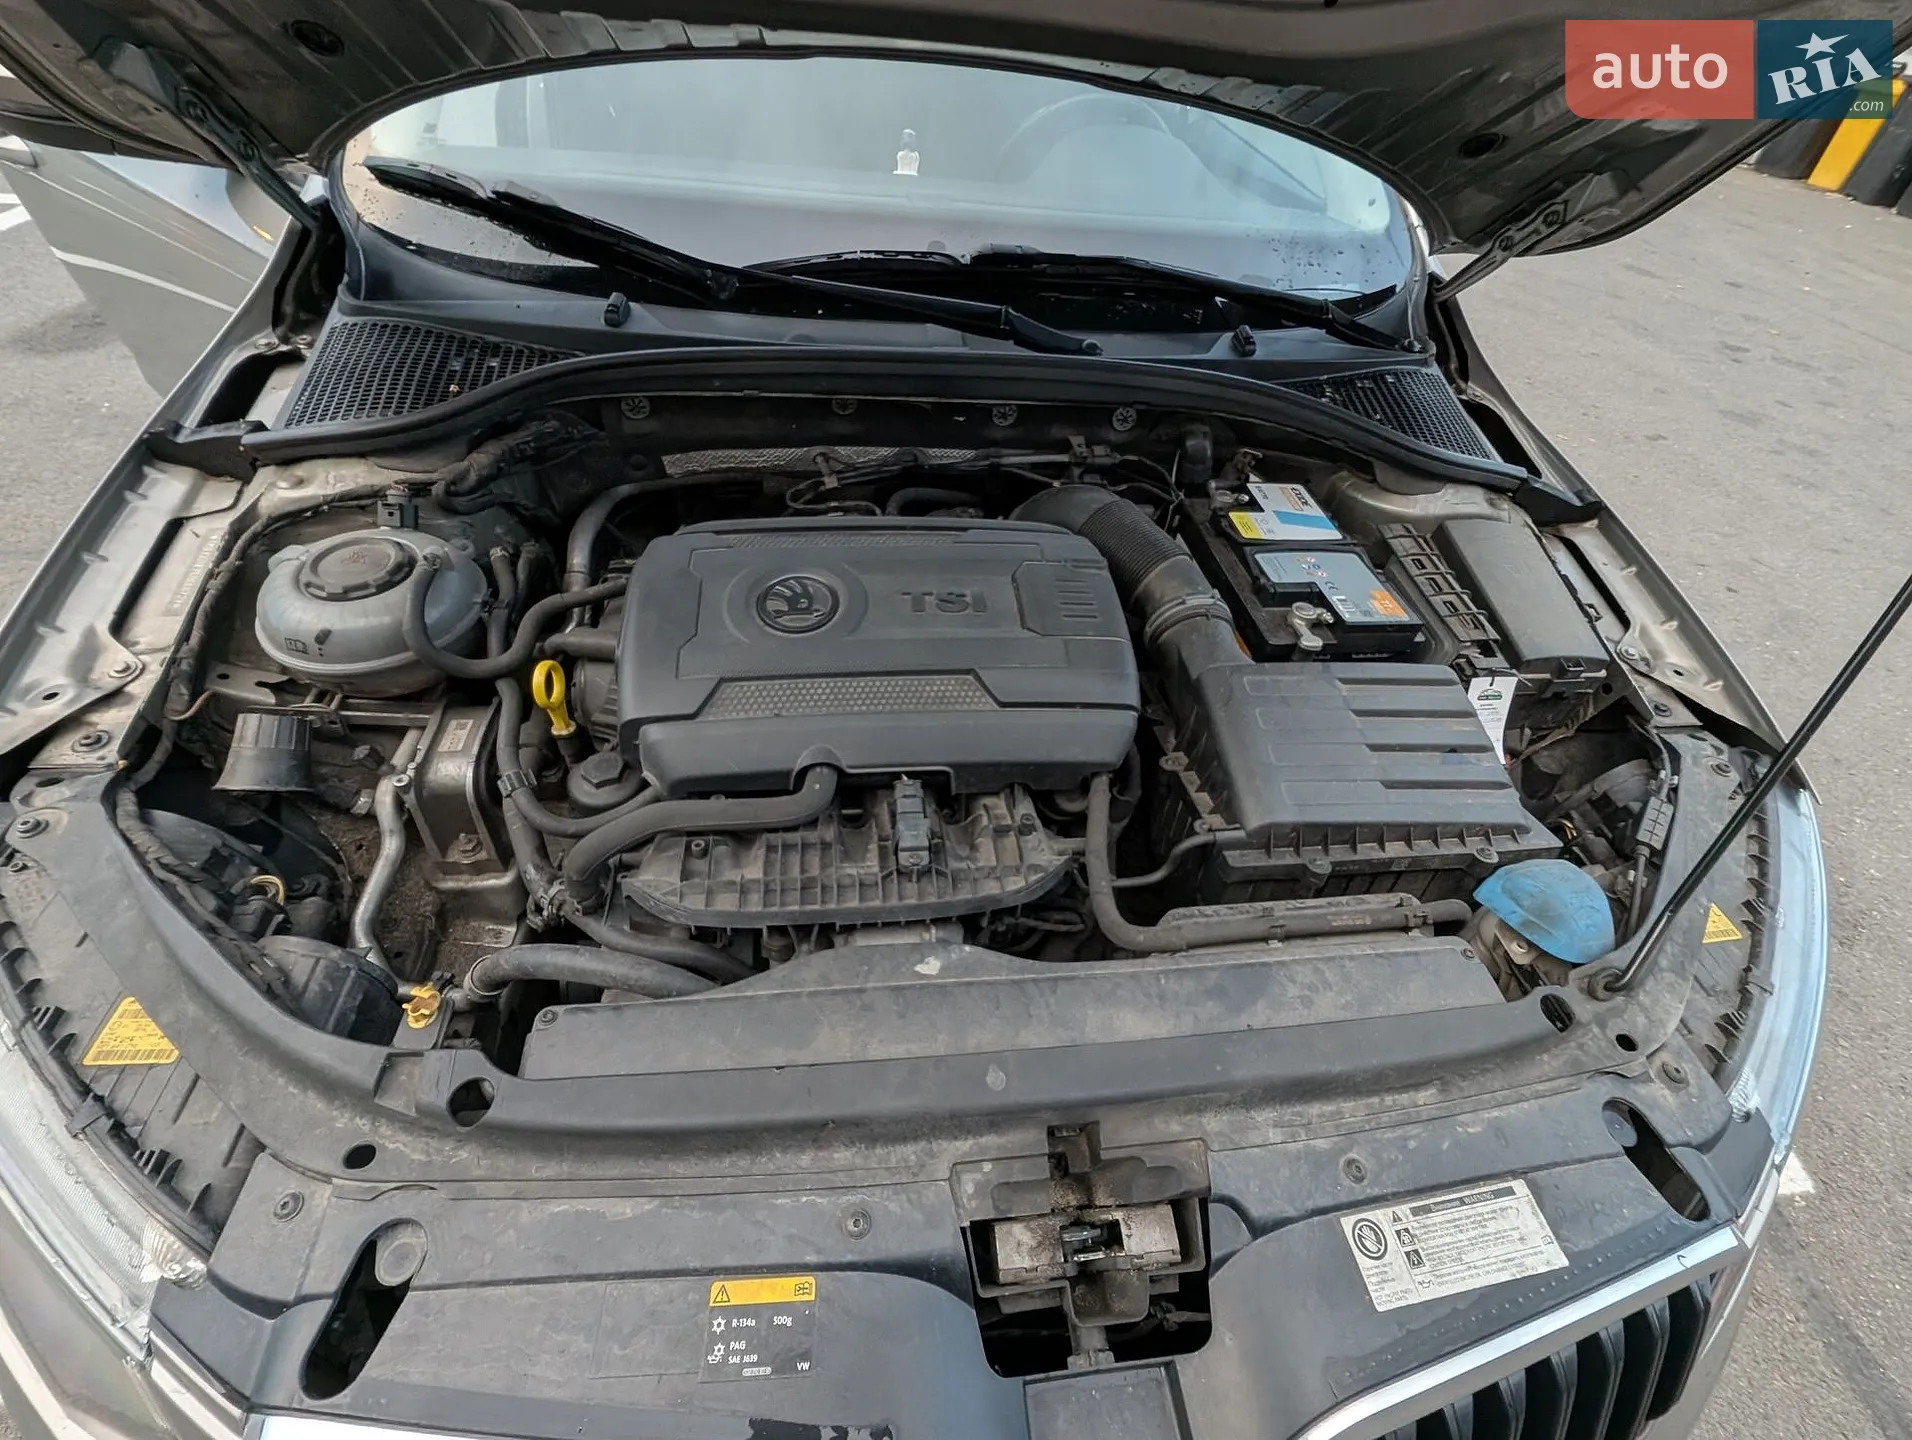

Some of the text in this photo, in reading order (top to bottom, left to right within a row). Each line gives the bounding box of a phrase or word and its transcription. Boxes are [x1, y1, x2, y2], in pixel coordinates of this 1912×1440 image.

[900, 590, 988, 613] TSI
[1462, 1190, 1495, 1205] WARNING
[732, 1316, 793, 1328] R-134a 500g
[729, 1341, 746, 1350] PAG
[728, 1354, 758, 1364] SAE J639
[796, 1361, 810, 1370] VW
